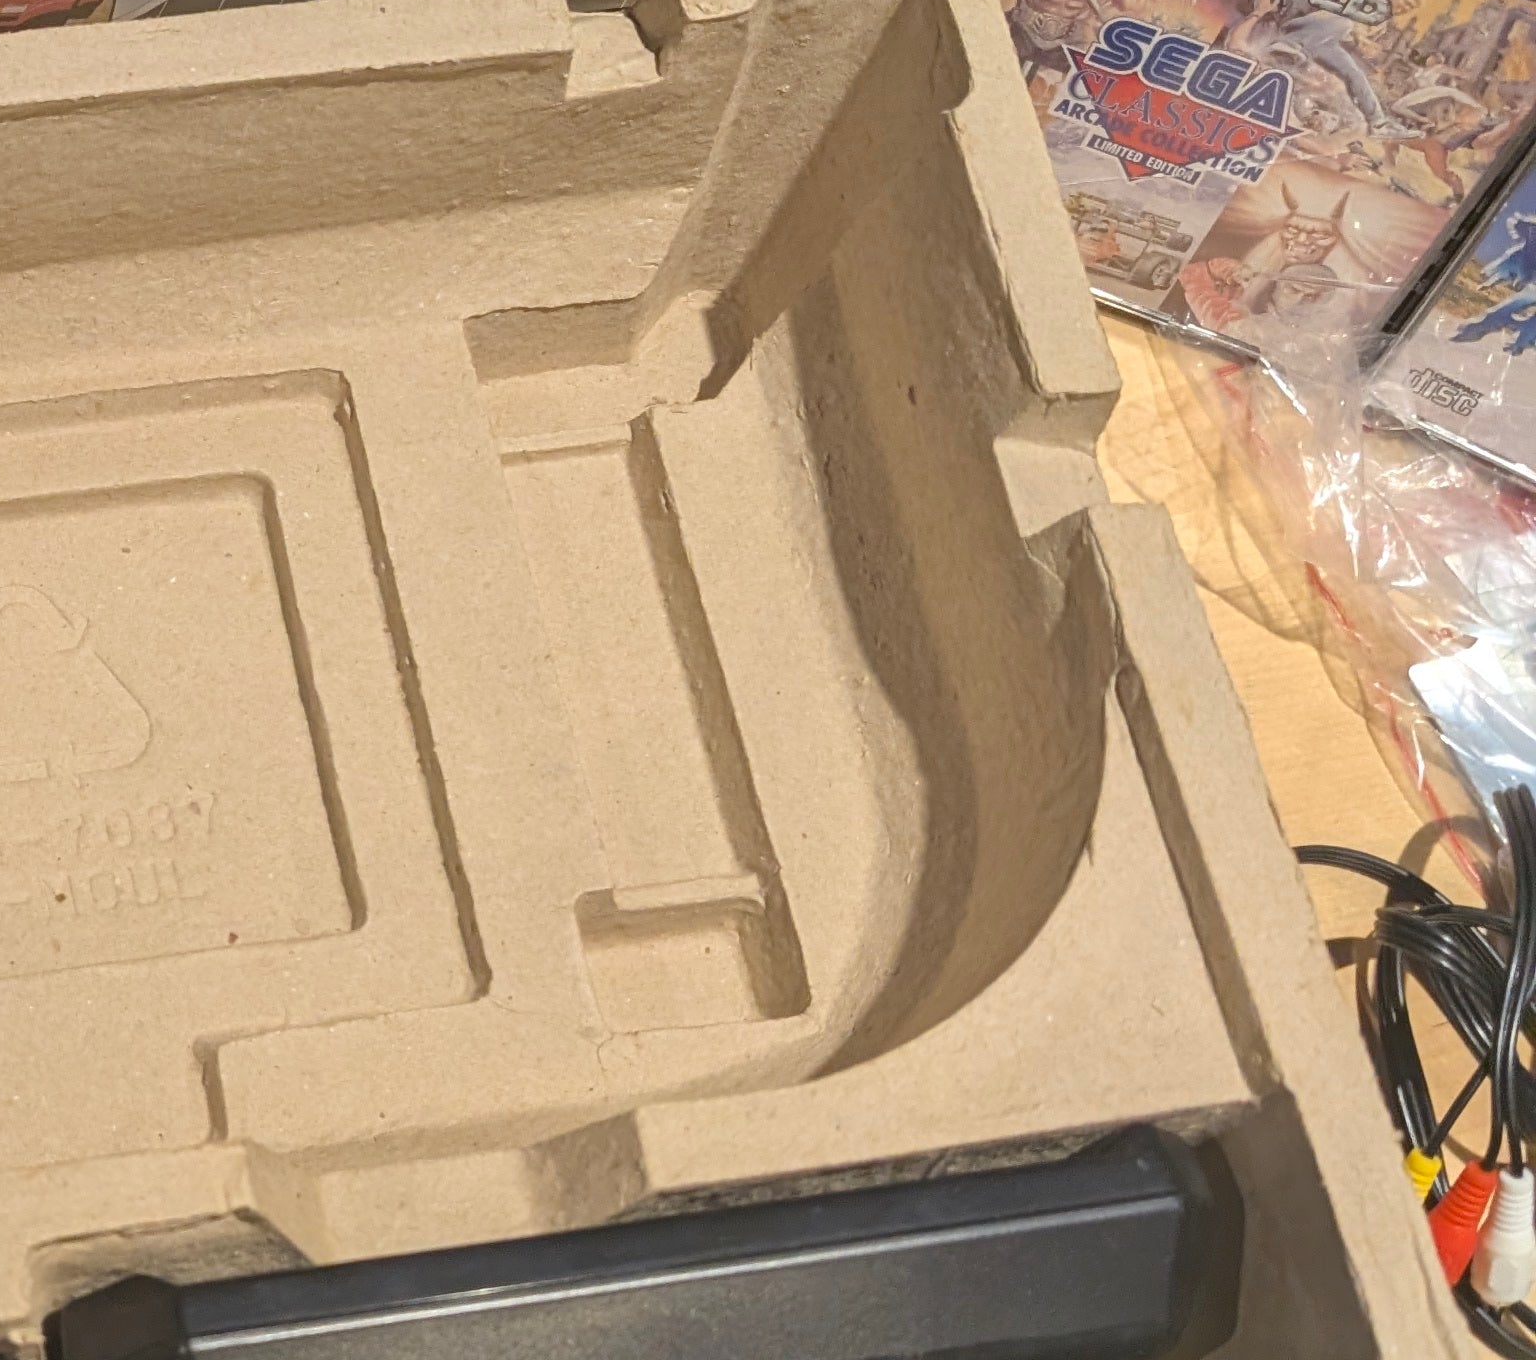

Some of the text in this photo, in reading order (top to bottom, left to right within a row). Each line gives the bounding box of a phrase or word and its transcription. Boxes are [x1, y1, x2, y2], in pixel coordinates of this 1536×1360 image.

[1068, 69, 1281, 165] CLASSICS
[1084, 17, 1295, 131] SEGA
[1054, 99, 1264, 183] ARCADE COLLECTION
[1093, 139, 1196, 182] LIMITED EDITION
